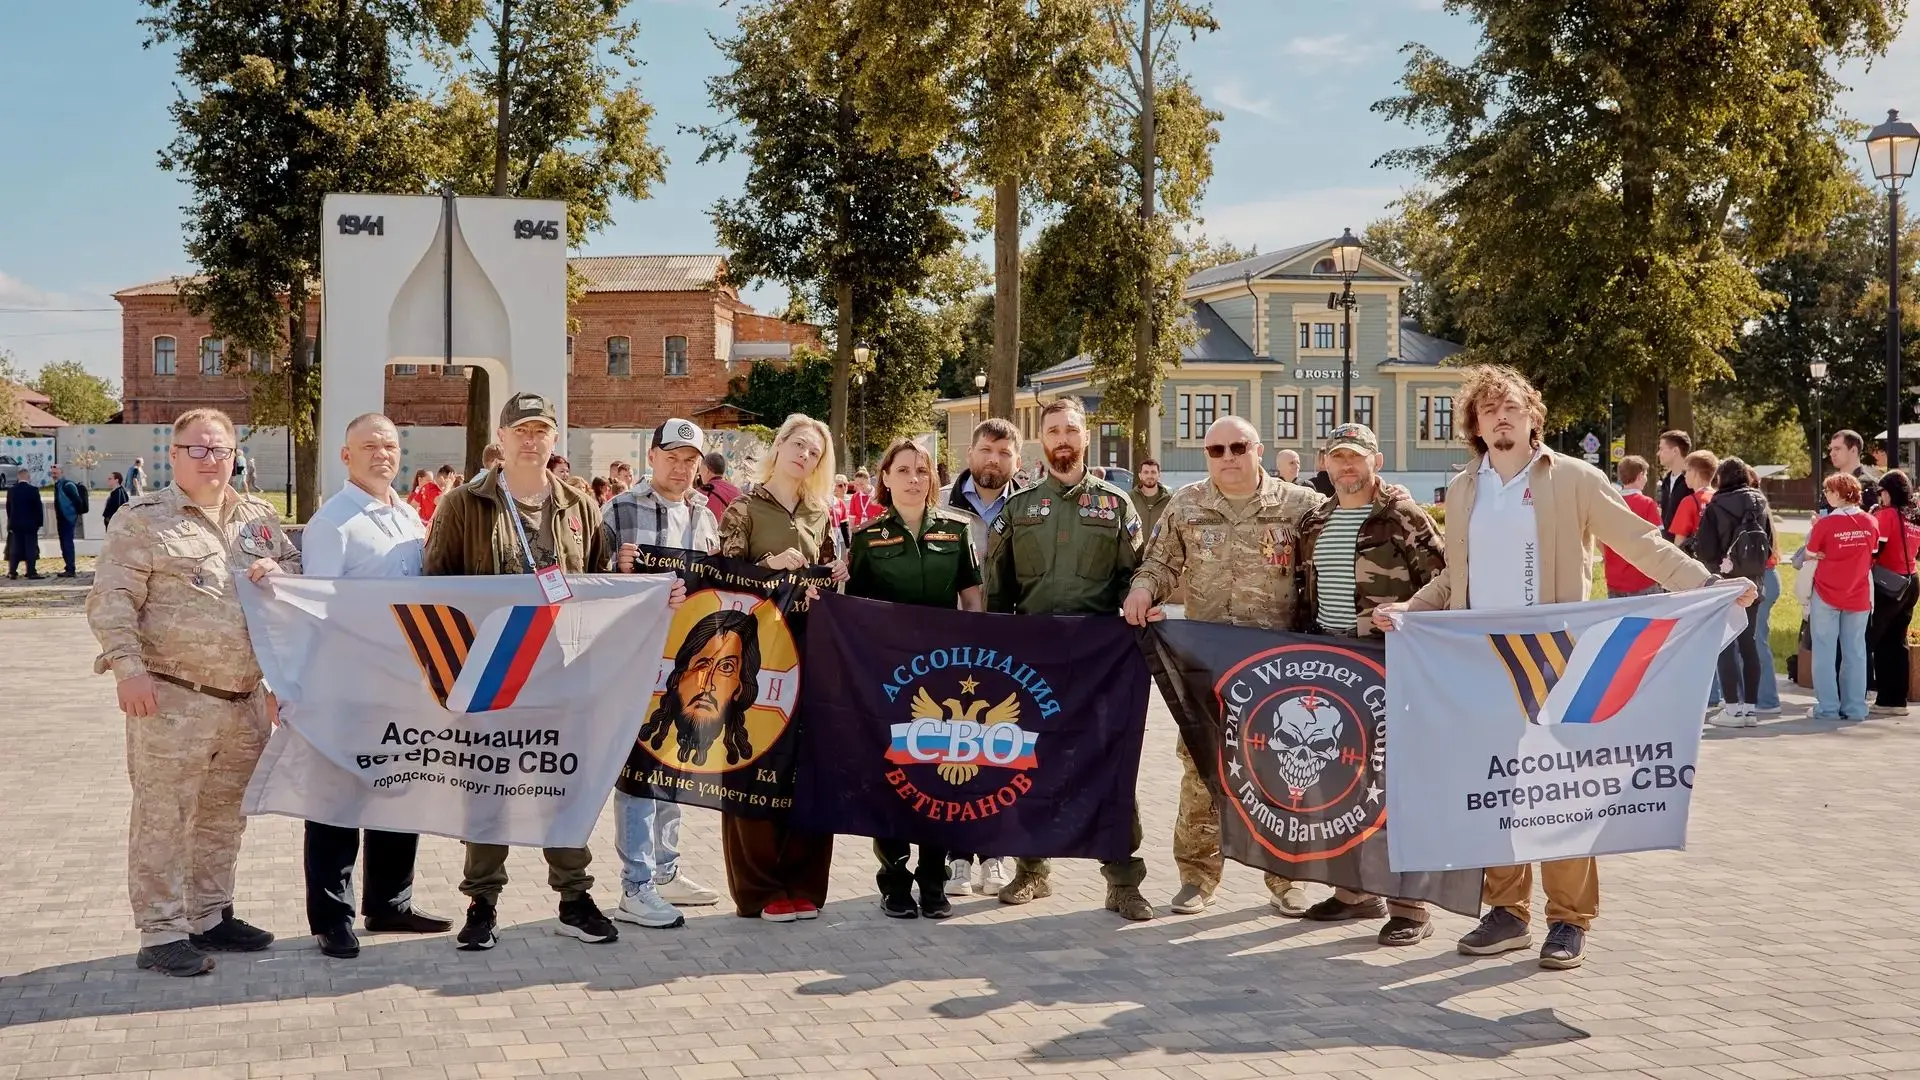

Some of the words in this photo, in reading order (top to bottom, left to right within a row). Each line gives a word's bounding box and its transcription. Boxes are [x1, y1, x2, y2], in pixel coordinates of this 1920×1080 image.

[337, 214, 384, 236] 1941
[513, 219, 559, 240] 1945
[1305, 369, 1360, 379] ROSTI'S
[658, 557, 685, 570] есмь
[690, 562, 723, 580] путь
[737, 575, 786, 590] истин
[1525, 542, 1534, 607] АСТАВНИК
[882, 646, 1061, 720] АССОЦИАЦИЯ
[1225, 679, 1253, 750] PMC
[1252, 658, 1363, 688] Wagner
[1362, 684, 1386, 772] Group
[380, 721, 560, 749] Ассоциация
[906, 717, 1024, 765] СВО
[356, 747, 511, 774] ветеранов
[518, 750, 579, 776] СВО
[1487, 741, 1673, 780] Ассоциация
[373, 770, 446, 789] городской
[450, 777, 491, 797] округ
[493, 783, 566, 798] Люберцы
[647, 769, 673, 787] Мя
[676, 777, 695, 791] не
[749, 794, 767, 806] во
[885, 767, 1033, 822] ВЕТЕРАНОВ
[1467, 777, 1622, 811] ветеранов
[1631, 764, 1696, 791] СВО
[1238, 780, 1285, 838] Группа
[1288, 803, 1367, 842] Вагнера
[1499, 807, 1593, 830] Московской
[1598, 801, 1667, 819] области
